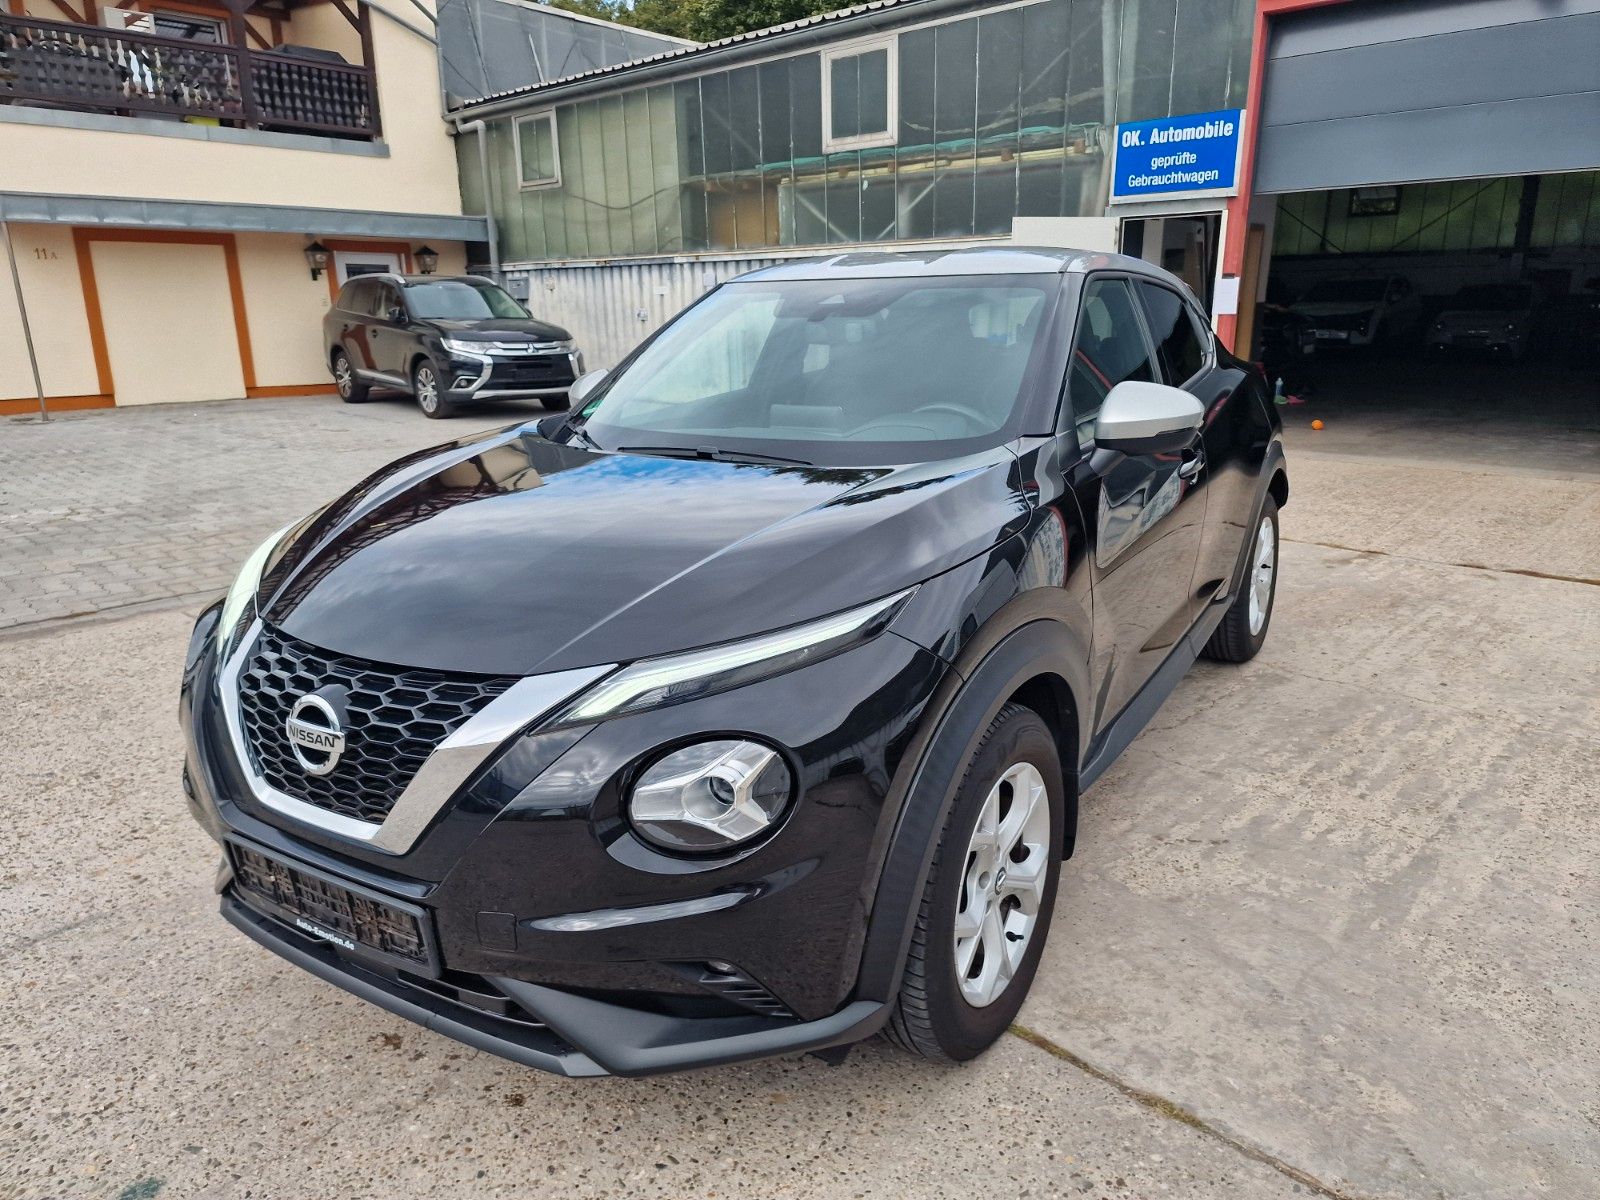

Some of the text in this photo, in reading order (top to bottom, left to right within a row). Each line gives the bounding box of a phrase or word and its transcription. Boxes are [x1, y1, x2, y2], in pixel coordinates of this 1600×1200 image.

[1122, 120, 1234, 147] OK. Automobile
[1151, 152, 1197, 170] geprüfte
[1128, 169, 1219, 187] Gebrauchtwagen
[289, 725, 335, 748] NISSAN
